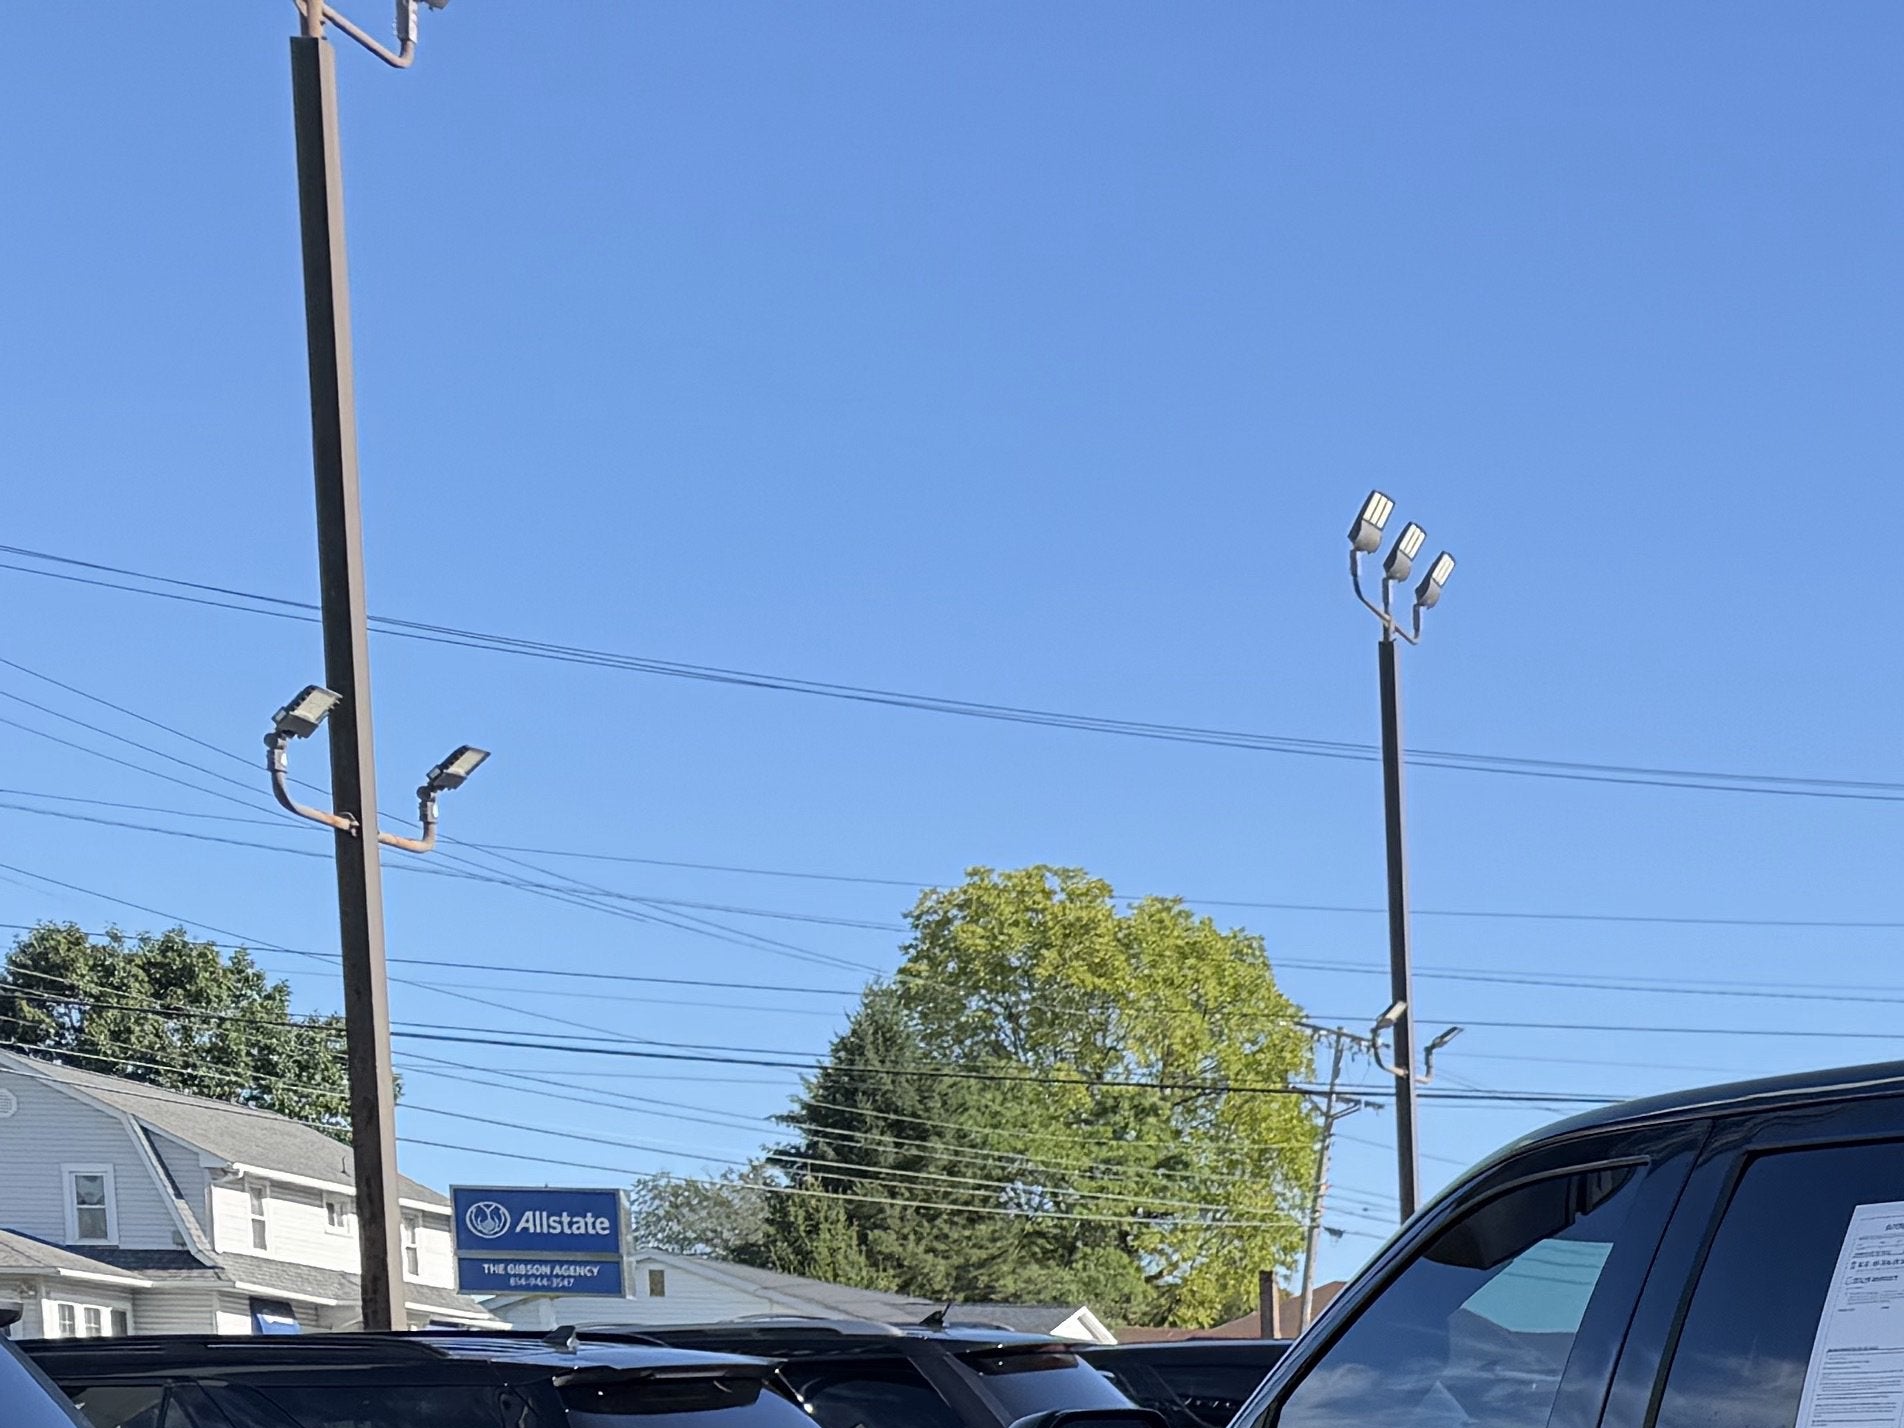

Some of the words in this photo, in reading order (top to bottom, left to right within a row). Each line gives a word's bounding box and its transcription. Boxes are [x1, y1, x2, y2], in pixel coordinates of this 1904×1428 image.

[515, 1210, 611, 1235] Allstate
[482, 1263, 505, 1275] THE
[507, 1263, 552, 1276] GIBSON
[552, 1264, 600, 1277] AGENCY
